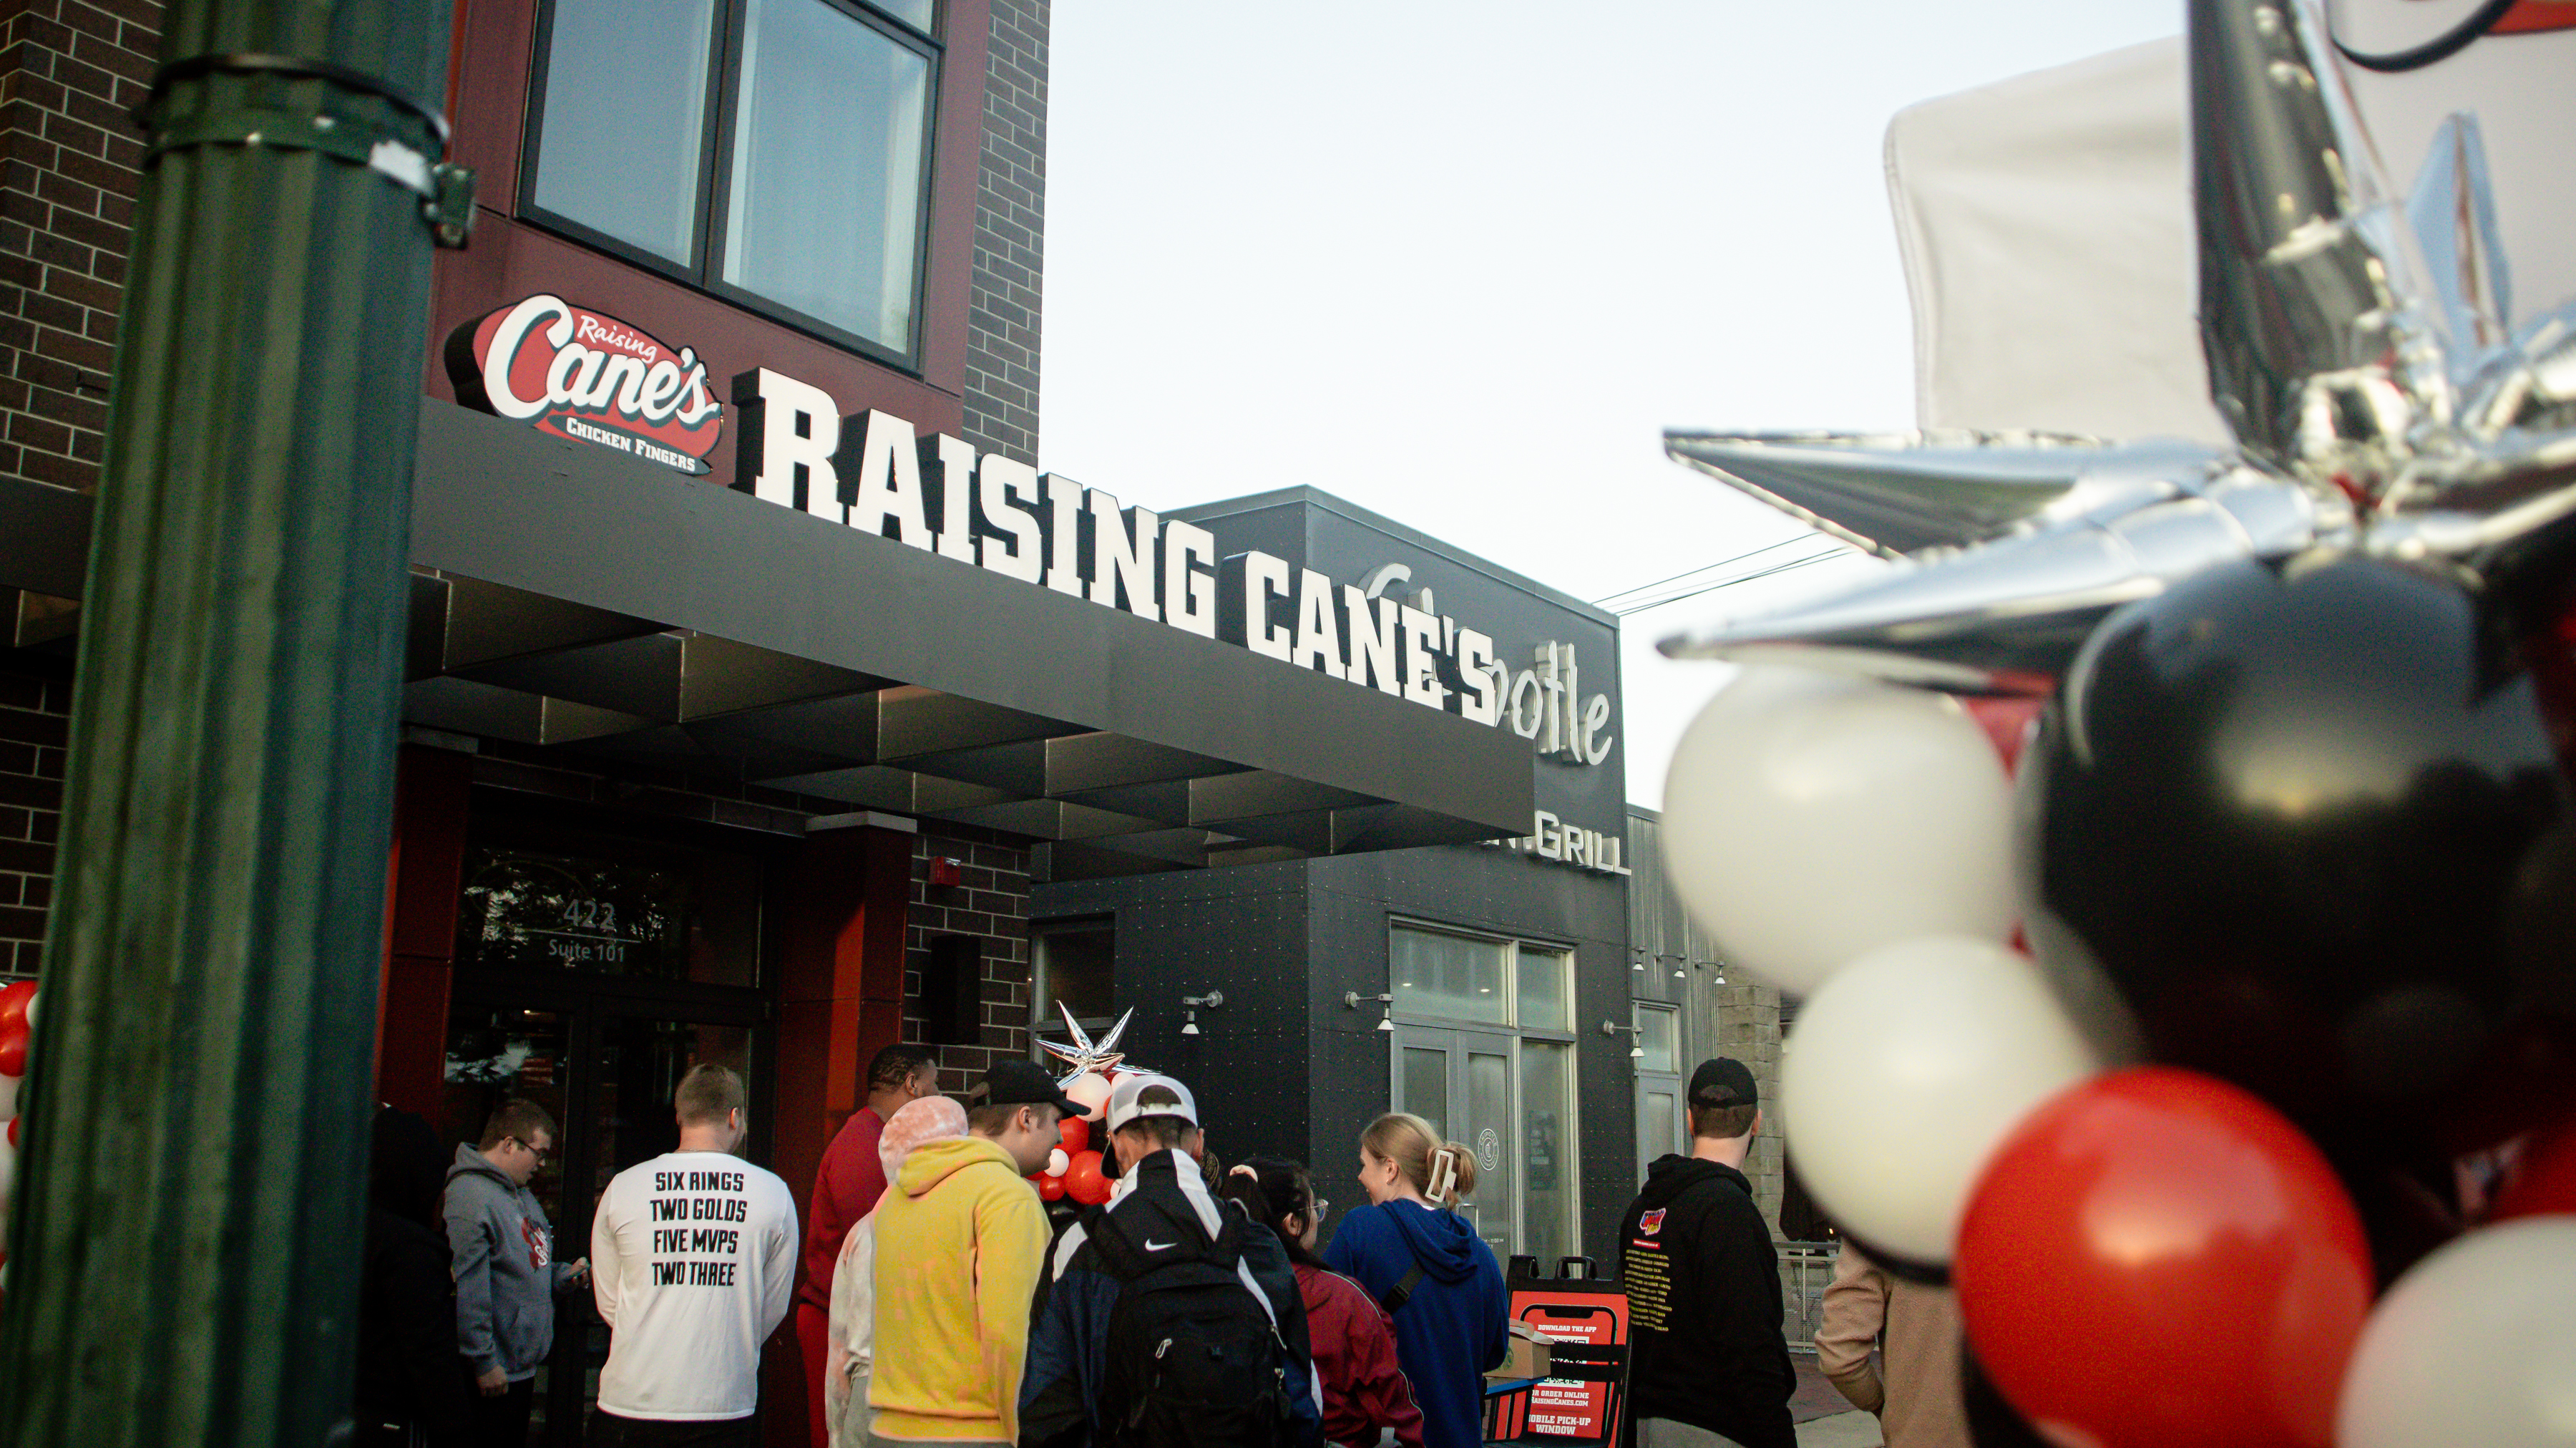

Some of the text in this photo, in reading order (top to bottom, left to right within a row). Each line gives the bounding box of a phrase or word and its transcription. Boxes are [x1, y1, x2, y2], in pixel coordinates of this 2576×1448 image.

[577, 315, 657, 364] Raising
[484, 295, 720, 424] Cane's
[566, 417, 696, 472] CHICKEN FINGERS
[755, 366, 1497, 727] RAISING CANE'S
[1534, 810, 1632, 875] GRILL
[563, 899, 615, 930] 422
[549, 938, 625, 962] Suite 101
[655, 1172, 745, 1192] SIX RINGS
[650, 1198, 748, 1223] TWO GOLDS
[654, 1229, 738, 1254] FIVE MVPS
[652, 1261, 737, 1286] TWO THREE
[1528, 1414, 1591, 1426] OBILE PICK-UP
[1536, 1424, 1576, 1435] WINDOW
